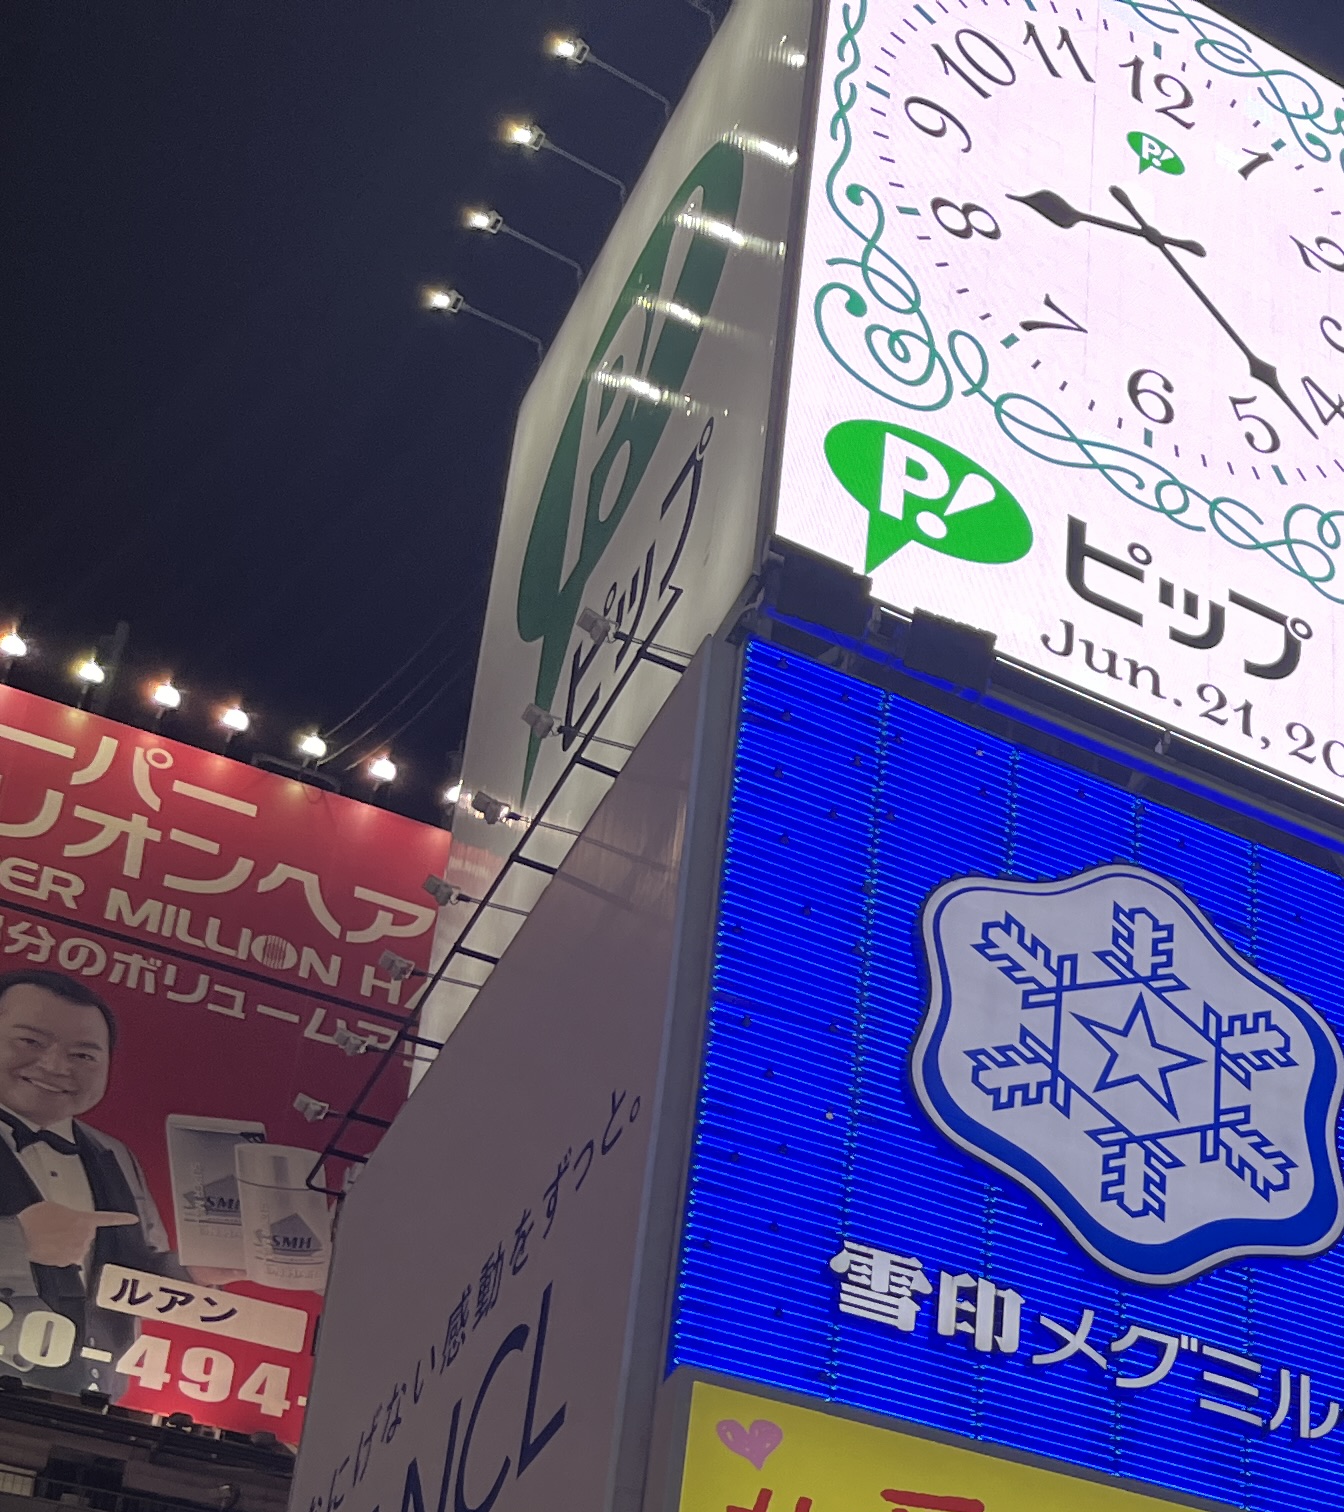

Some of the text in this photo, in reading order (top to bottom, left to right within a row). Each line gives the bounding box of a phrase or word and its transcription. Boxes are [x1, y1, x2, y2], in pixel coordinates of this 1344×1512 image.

[932, 29, 1016, 99] 10
[1022, 20, 1096, 84] 11
[1118, 56, 1196, 129] 12
[903, 96, 973, 154] 9
[1236, 149, 1275, 181] 1
[930, 197, 1002, 241] 8
[1019, 294, 1089, 335] 7
[1126, 368, 1176, 426] 6
[1228, 396, 1282, 456] 5
[1065, 513, 1314, 681] ピップ
[1040, 617, 1183, 708] Jun.
[1196, 683, 1272, 750] 21,
[104, 887, 342, 987] MILLION
[0, 914, 414, 1056] 分のボリュームア
[110, 1278, 238, 1322] ルアン
